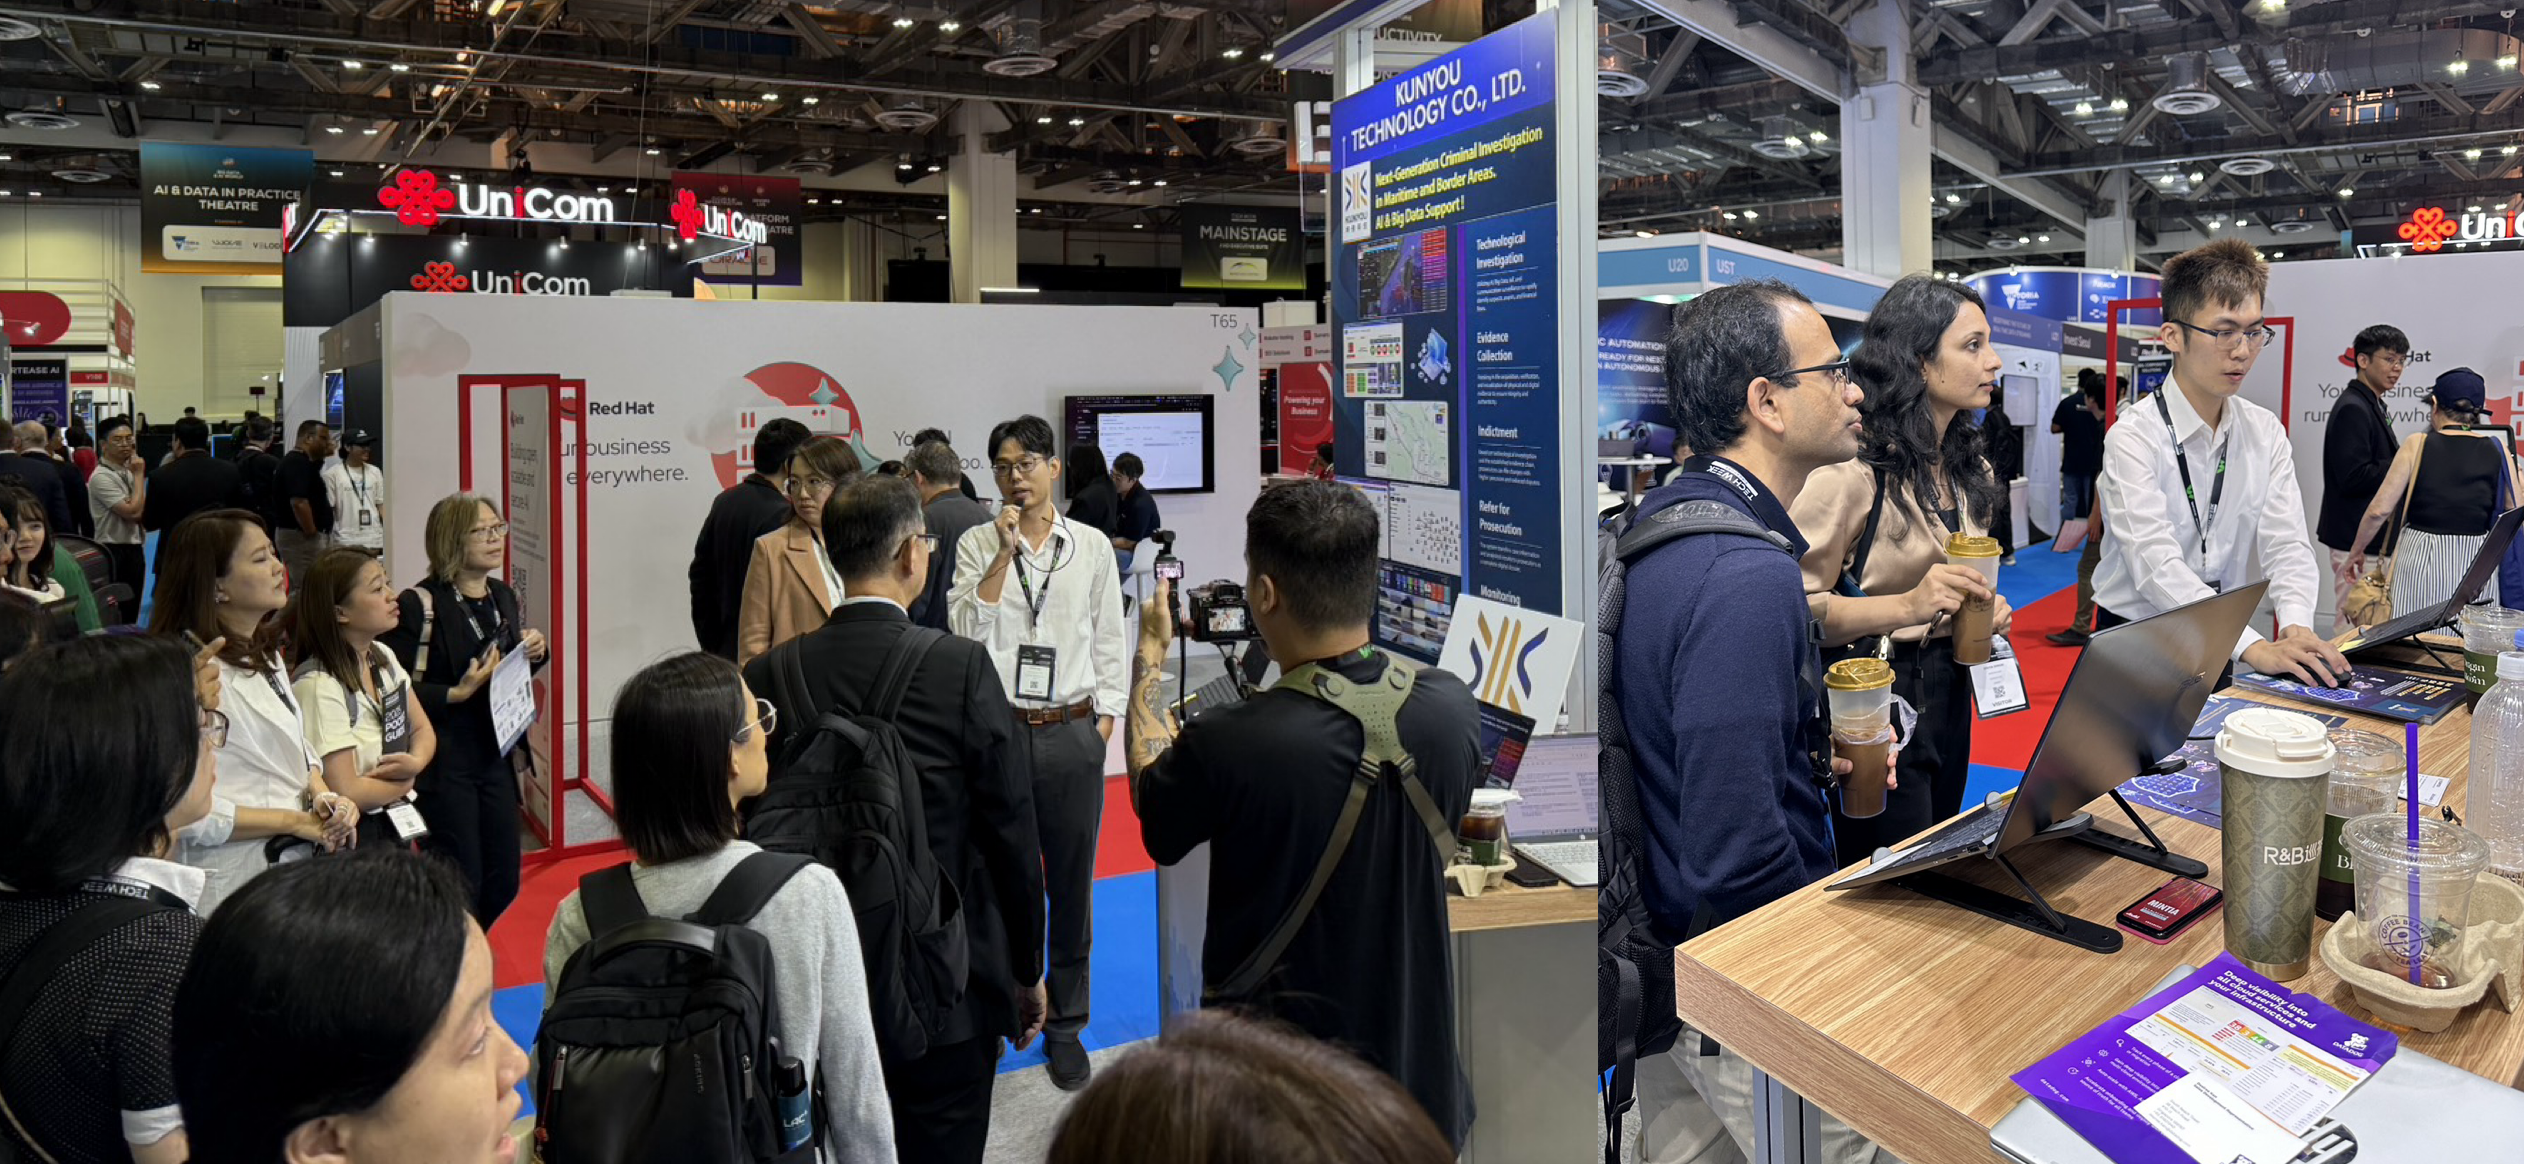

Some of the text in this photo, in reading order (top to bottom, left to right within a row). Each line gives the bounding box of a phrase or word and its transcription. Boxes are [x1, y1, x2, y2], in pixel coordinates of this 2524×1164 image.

[1395, 58, 1461, 107] KUNYOU
[1351, 69, 1526, 151] TECHNOLOGY CO., LTD.
[1375, 126, 1543, 187] Next-Generation Criminal Investigation
[153, 185, 300, 200] AI & DATA IN PRACTICE
[1375, 166, 1497, 208] in Maritime and Border Areas.
[199, 199, 259, 212] THEATRE
[458, 184, 614, 223] UniCom
[704, 204, 768, 244] UniCom
[1405, 207, 1424, 223] Data
[1200, 225, 1288, 242] MAINSTAGE
[1476, 230, 1526, 251] Technological
[1476, 252, 1524, 270] Investigation
[1668, 258, 1689, 272] U20
[1716, 260, 1736, 275] UST
[472, 270, 590, 296] UniCom
[1211, 314, 1237, 328] T65
[1477, 331, 1509, 344] Evidence
[1477, 349, 1513, 362] Collection
[589, 401, 655, 415] Red Hat
[1478, 424, 1518, 439] Indictment
[566, 465, 689, 488] eerywhere.
[1706, 465, 1754, 501] TECH WEEK
[1479, 500, 1510, 515] Refer for
[1479, 518, 1522, 536] Prosecution
[1481, 584, 1521, 608] Monitoring
[120, 885, 149, 900] TECH
[2147, 899, 2180, 916] MINTIA
[2381, 919, 2426, 939] COFFEE BEAN
[2396, 951, 2428, 965] TEA LEAF
[2216, 975, 2318, 1029] all cloud services and
[2224, 970, 2309, 1017] Deep visibility into
[2207, 979, 2297, 1028] your infrastructure
[2333, 1041, 2364, 1057] DATADOG
[2039, 1078, 2071, 1102] datadog.com
